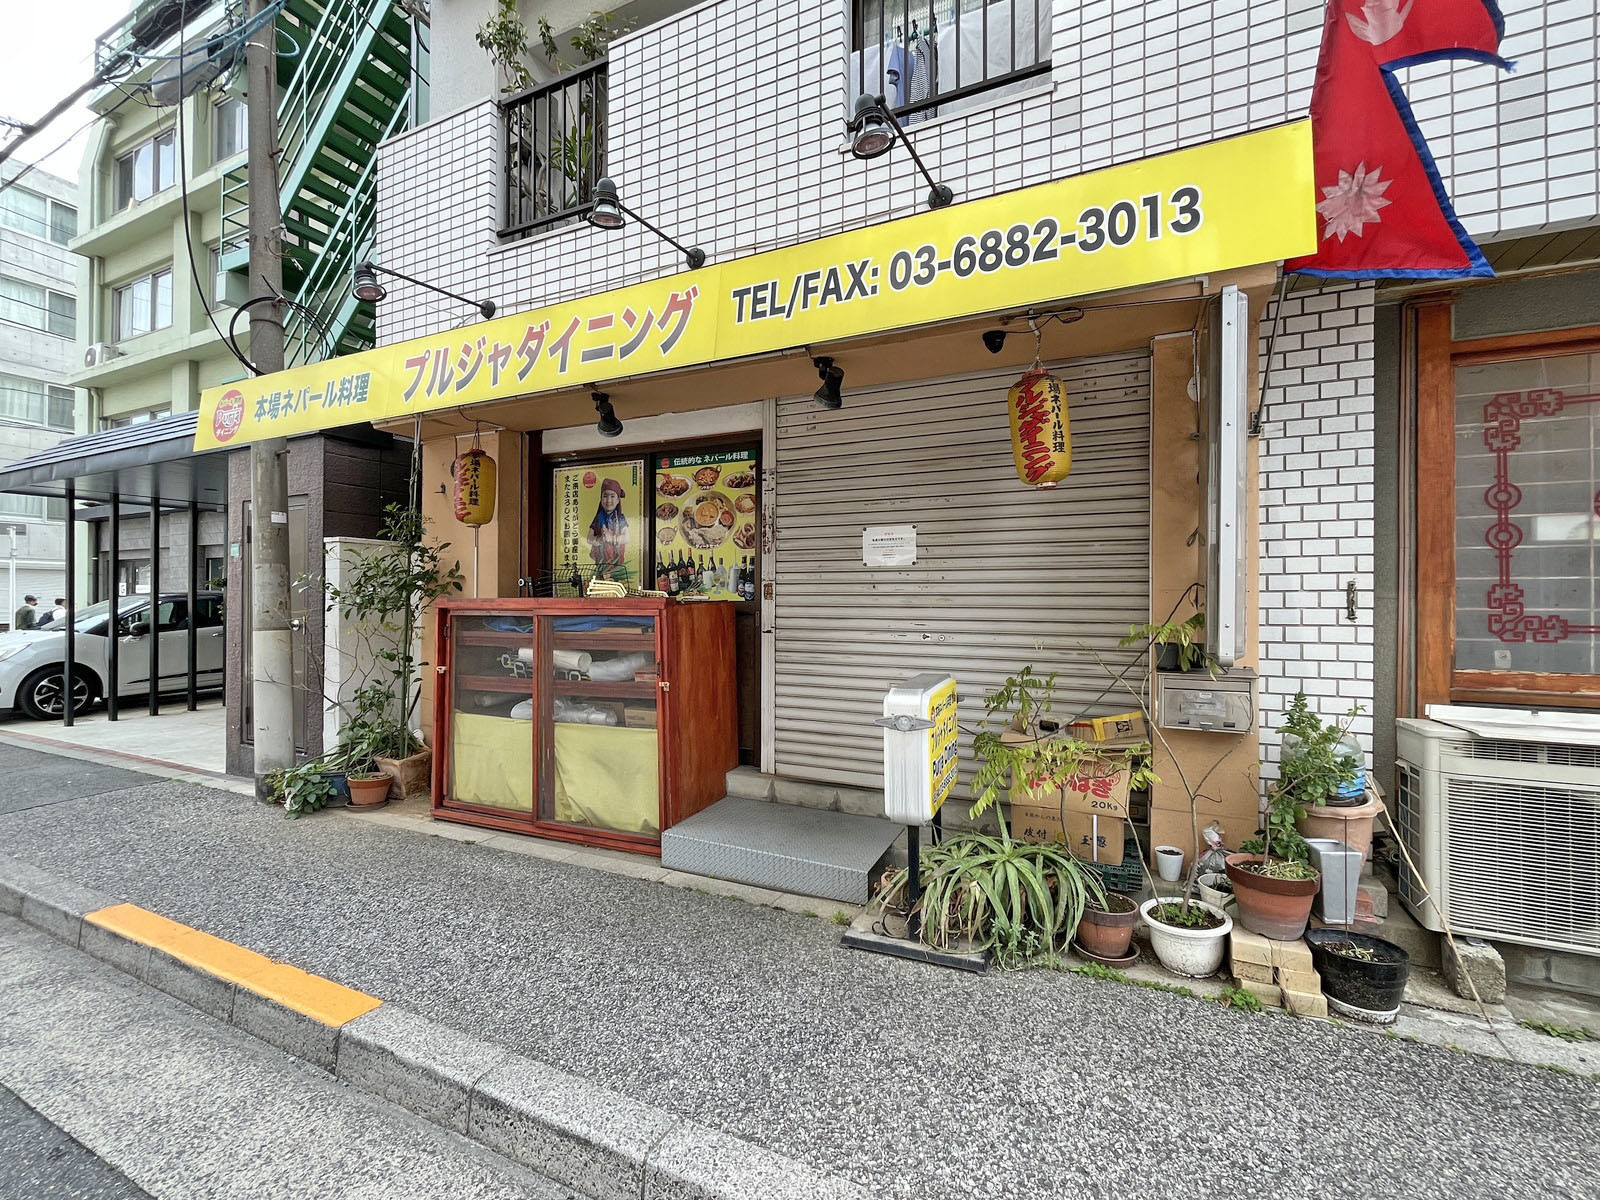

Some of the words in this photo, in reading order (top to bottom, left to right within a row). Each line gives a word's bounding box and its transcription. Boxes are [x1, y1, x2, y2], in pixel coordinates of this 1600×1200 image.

[732, 259, 879, 323] TEL/FAX:
[890, 185, 1202, 291] 03-6882-3013
[403, 287, 698, 402] プルジャダイニング
[254, 373, 369, 423] 本場ネパール料理
[674, 455, 702, 466] 伝統的な
[704, 451, 749, 463] ネパール料理
[572, 474, 580, 571] ご来店ありがとう御座いま
[1026, 770, 1114, 799] たねぎ
[1091, 800, 1118, 811] 20Kg
